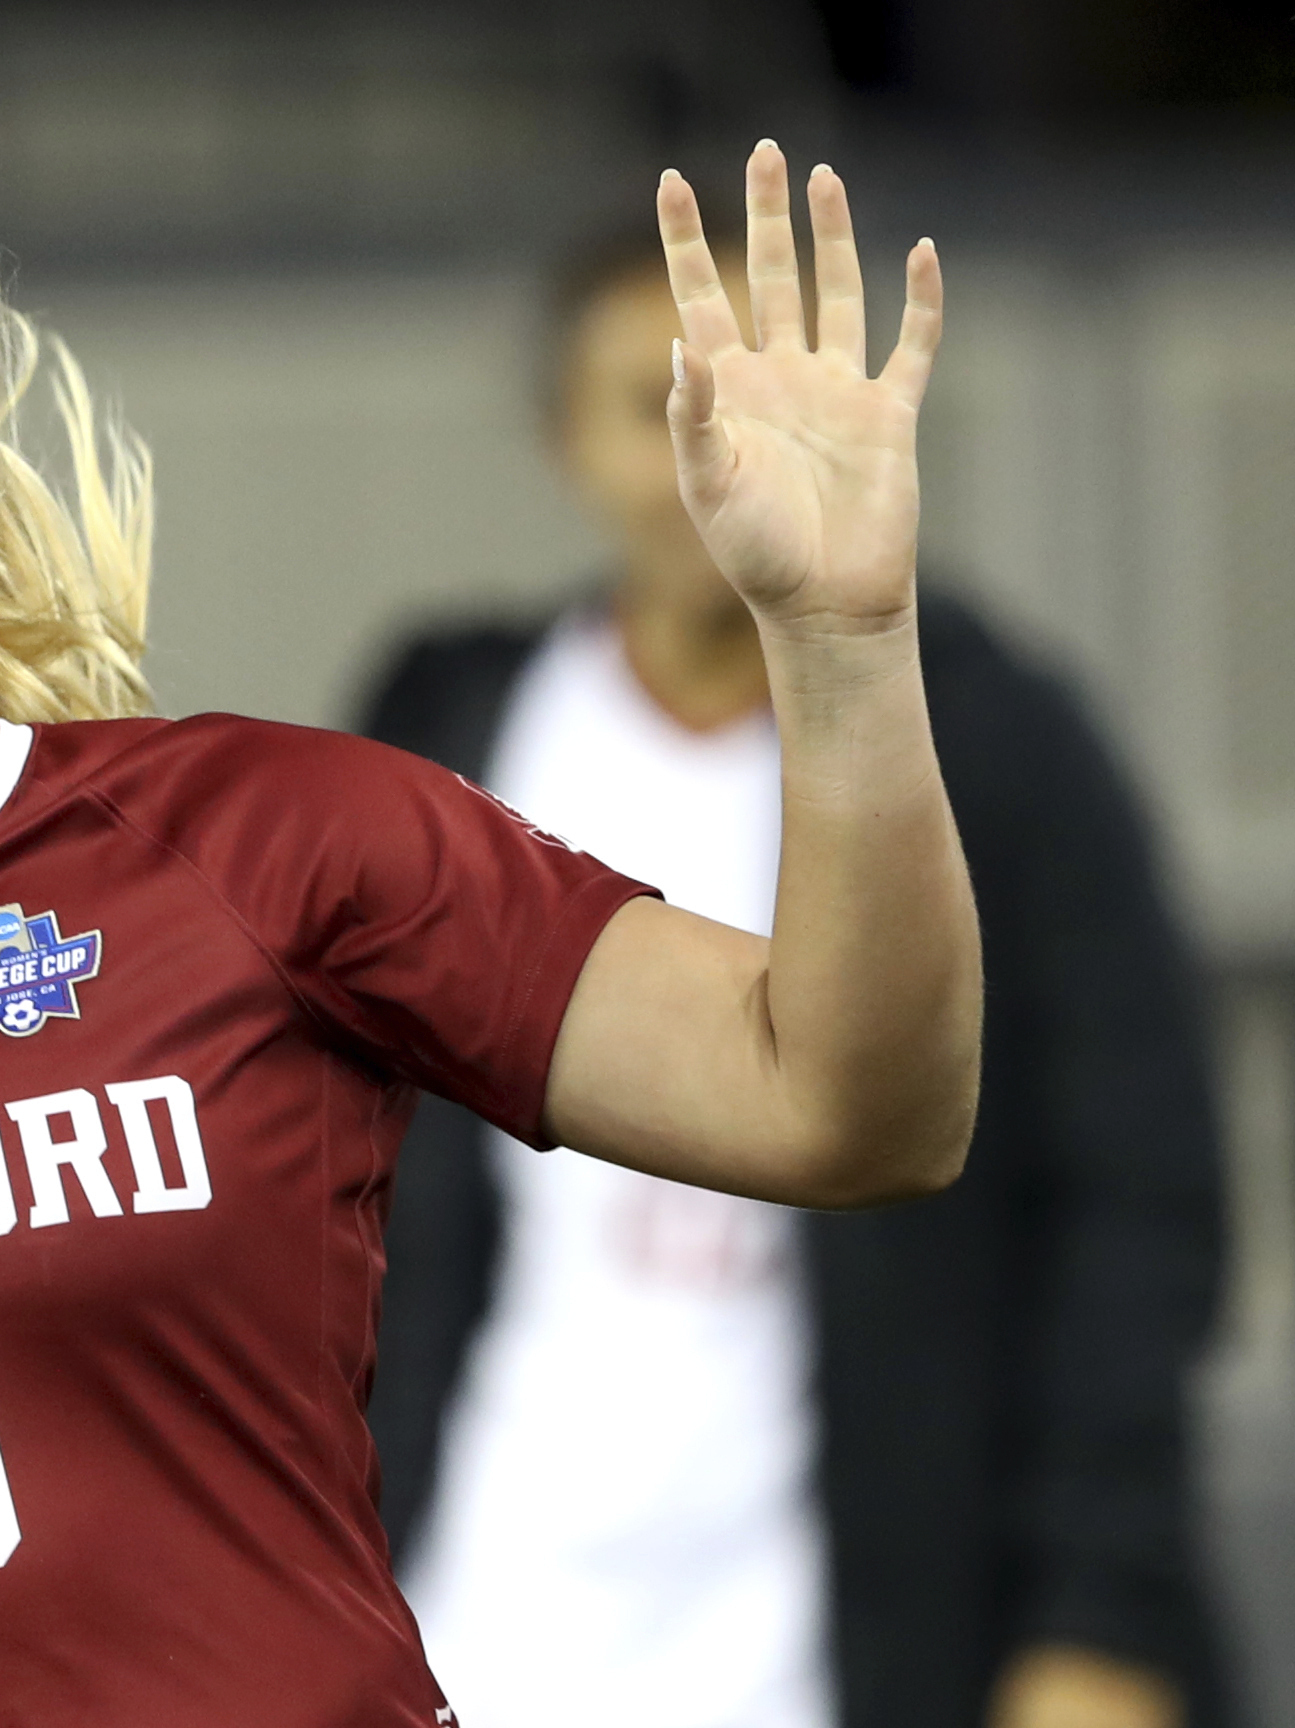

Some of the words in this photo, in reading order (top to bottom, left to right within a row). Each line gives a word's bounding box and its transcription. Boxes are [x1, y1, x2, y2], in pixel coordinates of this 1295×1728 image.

[0, 948, 48, 967] WOMEN'S
[41, 947, 87, 978] CUP
[40, 984, 57, 995] CA
